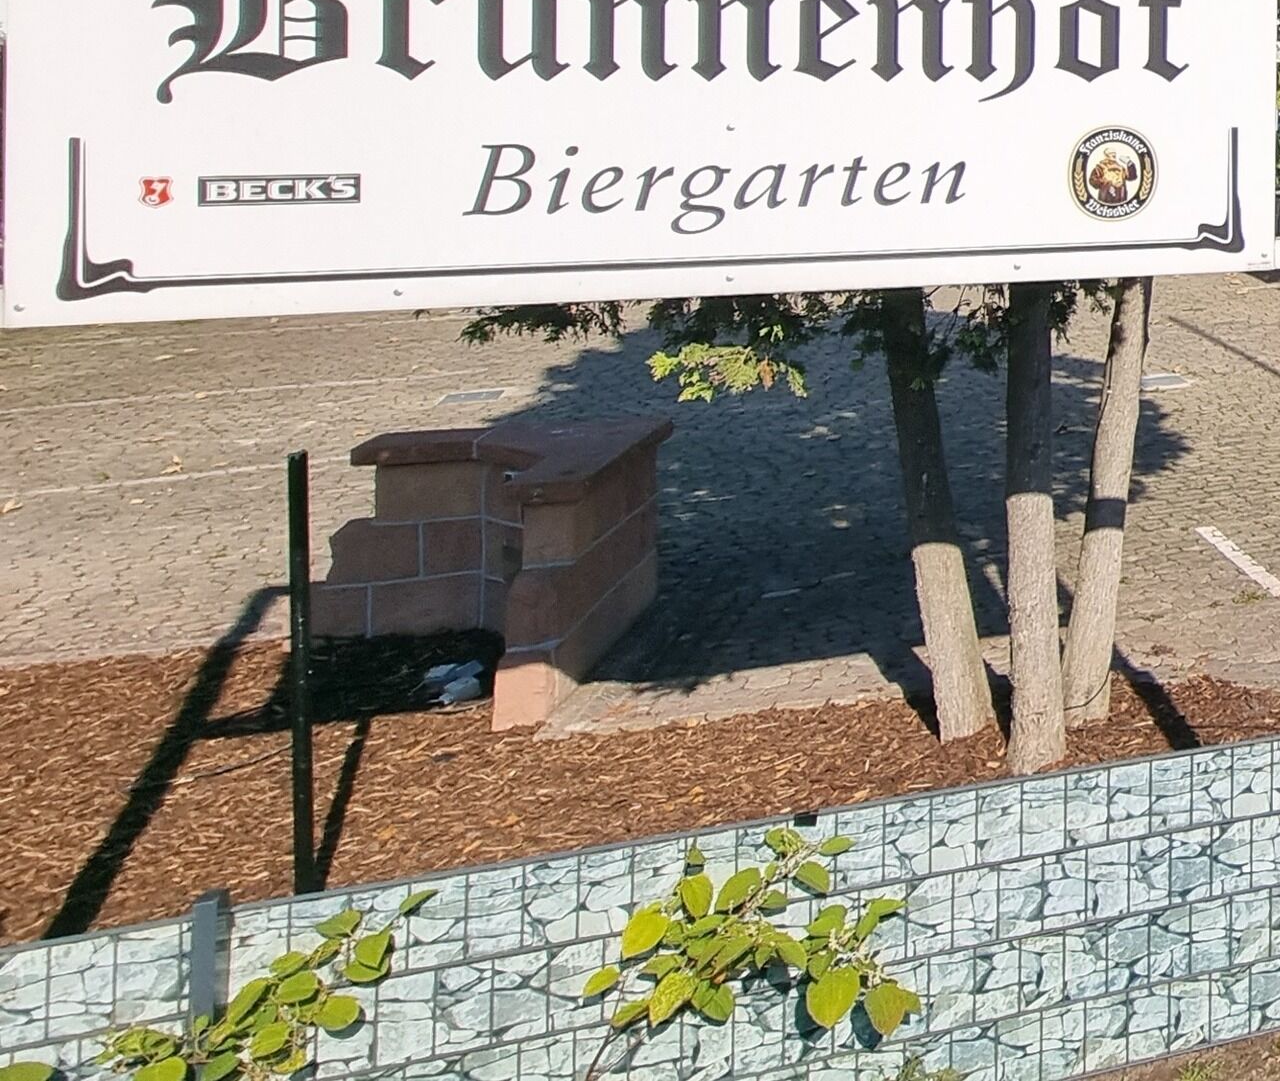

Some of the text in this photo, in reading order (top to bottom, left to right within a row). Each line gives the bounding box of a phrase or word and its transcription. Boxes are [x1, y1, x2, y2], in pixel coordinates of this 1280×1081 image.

[1079, 130, 1147, 156] Franziskaner
[204, 175, 357, 202] BECK'S
[463, 142, 967, 235] Biergarten
